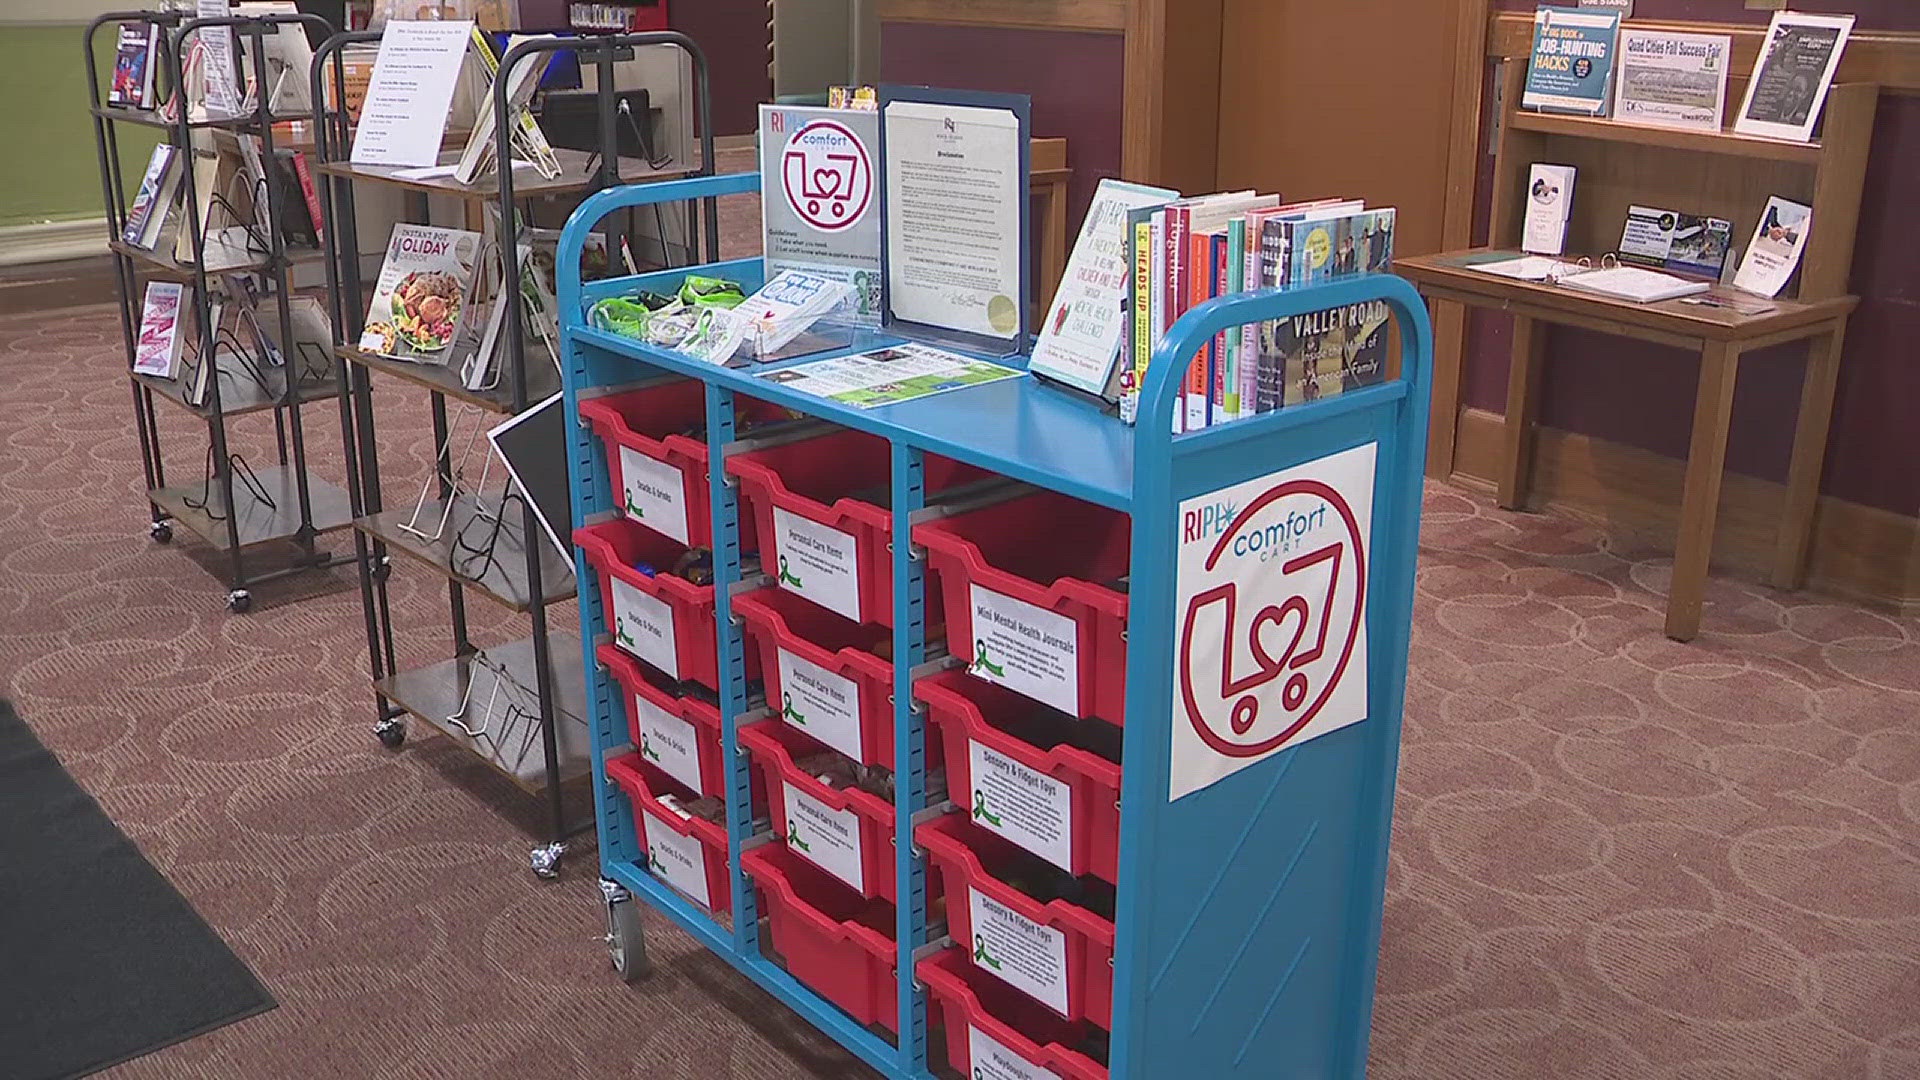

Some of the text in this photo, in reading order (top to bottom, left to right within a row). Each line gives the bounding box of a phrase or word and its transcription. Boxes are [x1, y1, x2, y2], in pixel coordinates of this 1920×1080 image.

[1537, 38, 1607, 58] JOB-HUNTING
[1561, 29, 1578, 38] BOOK
[1627, 38, 1720, 58] Quad Cities Fall Success Fair
[1534, 54, 1570, 71] HACKS
[803, 133, 848, 147] comfort
[391, 237, 450, 256] HOLIDAY
[401, 229, 449, 241] INSTANT POT
[1167, 220, 1184, 288] Together
[1138, 250, 1147, 311] HEADS UP
[1294, 300, 1384, 338] VALLEY ROAD
[1301, 349, 1327, 362] Inside
[1367, 333, 1378, 348] of
[1307, 364, 1350, 385] American
[1351, 357, 1379, 376] Family
[637, 480, 652, 494] Snacks
[657, 489, 671, 503] Drinks
[1184, 502, 1224, 545] RIPL
[1233, 502, 1326, 557] comfort
[788, 529, 843, 560] Personal Care Items
[1260, 538, 1303, 563] CART
[976, 605, 1074, 655] Mini Mental Health Journals
[793, 668, 846, 704] Personal Care Items
[983, 750, 1057, 796] Sensory & Fidget Toys
[797, 799, 849, 837] Personal Care Items
[982, 898, 1008, 921] Sensory
[1015, 915, 1035, 935] Fidget
[1035, 926, 1053, 943] Toys
